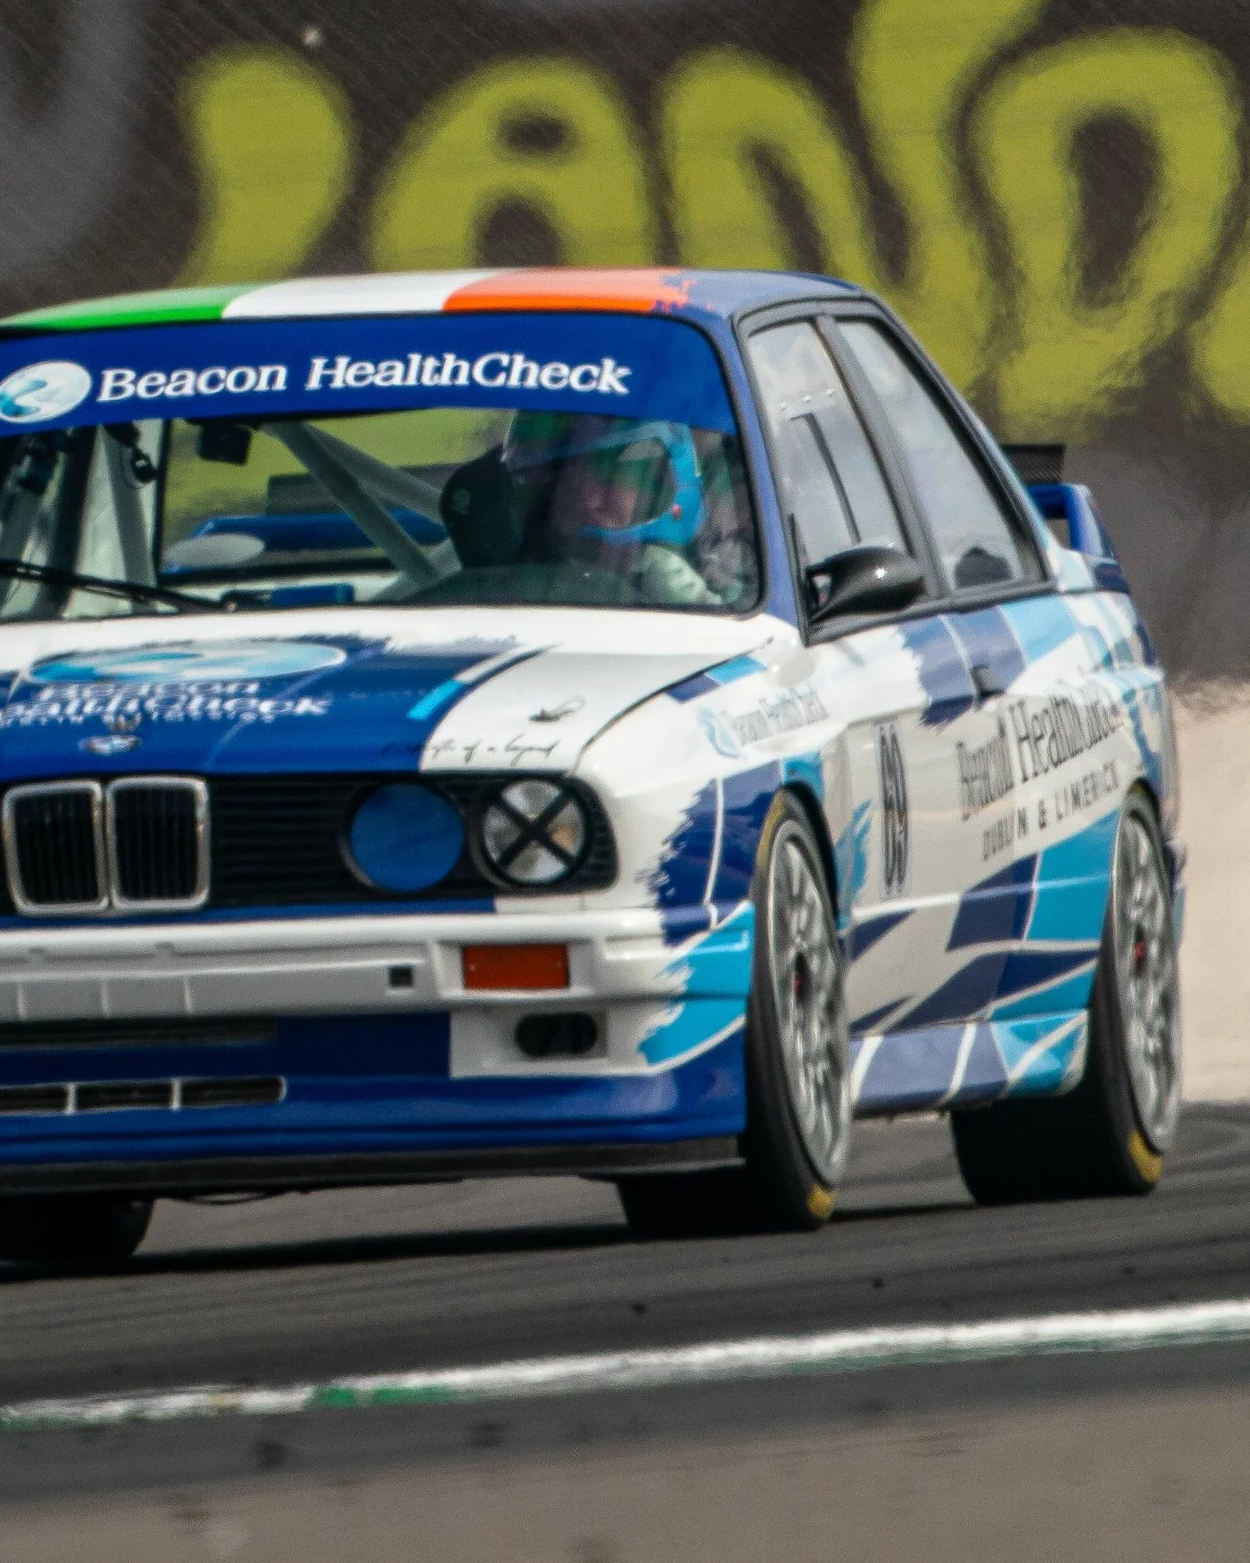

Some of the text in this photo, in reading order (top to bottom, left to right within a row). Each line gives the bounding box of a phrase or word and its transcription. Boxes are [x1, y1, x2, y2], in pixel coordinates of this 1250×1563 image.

[96, 351, 633, 403] Beacon HealthCheck
[1037, 798, 1048, 830] &
